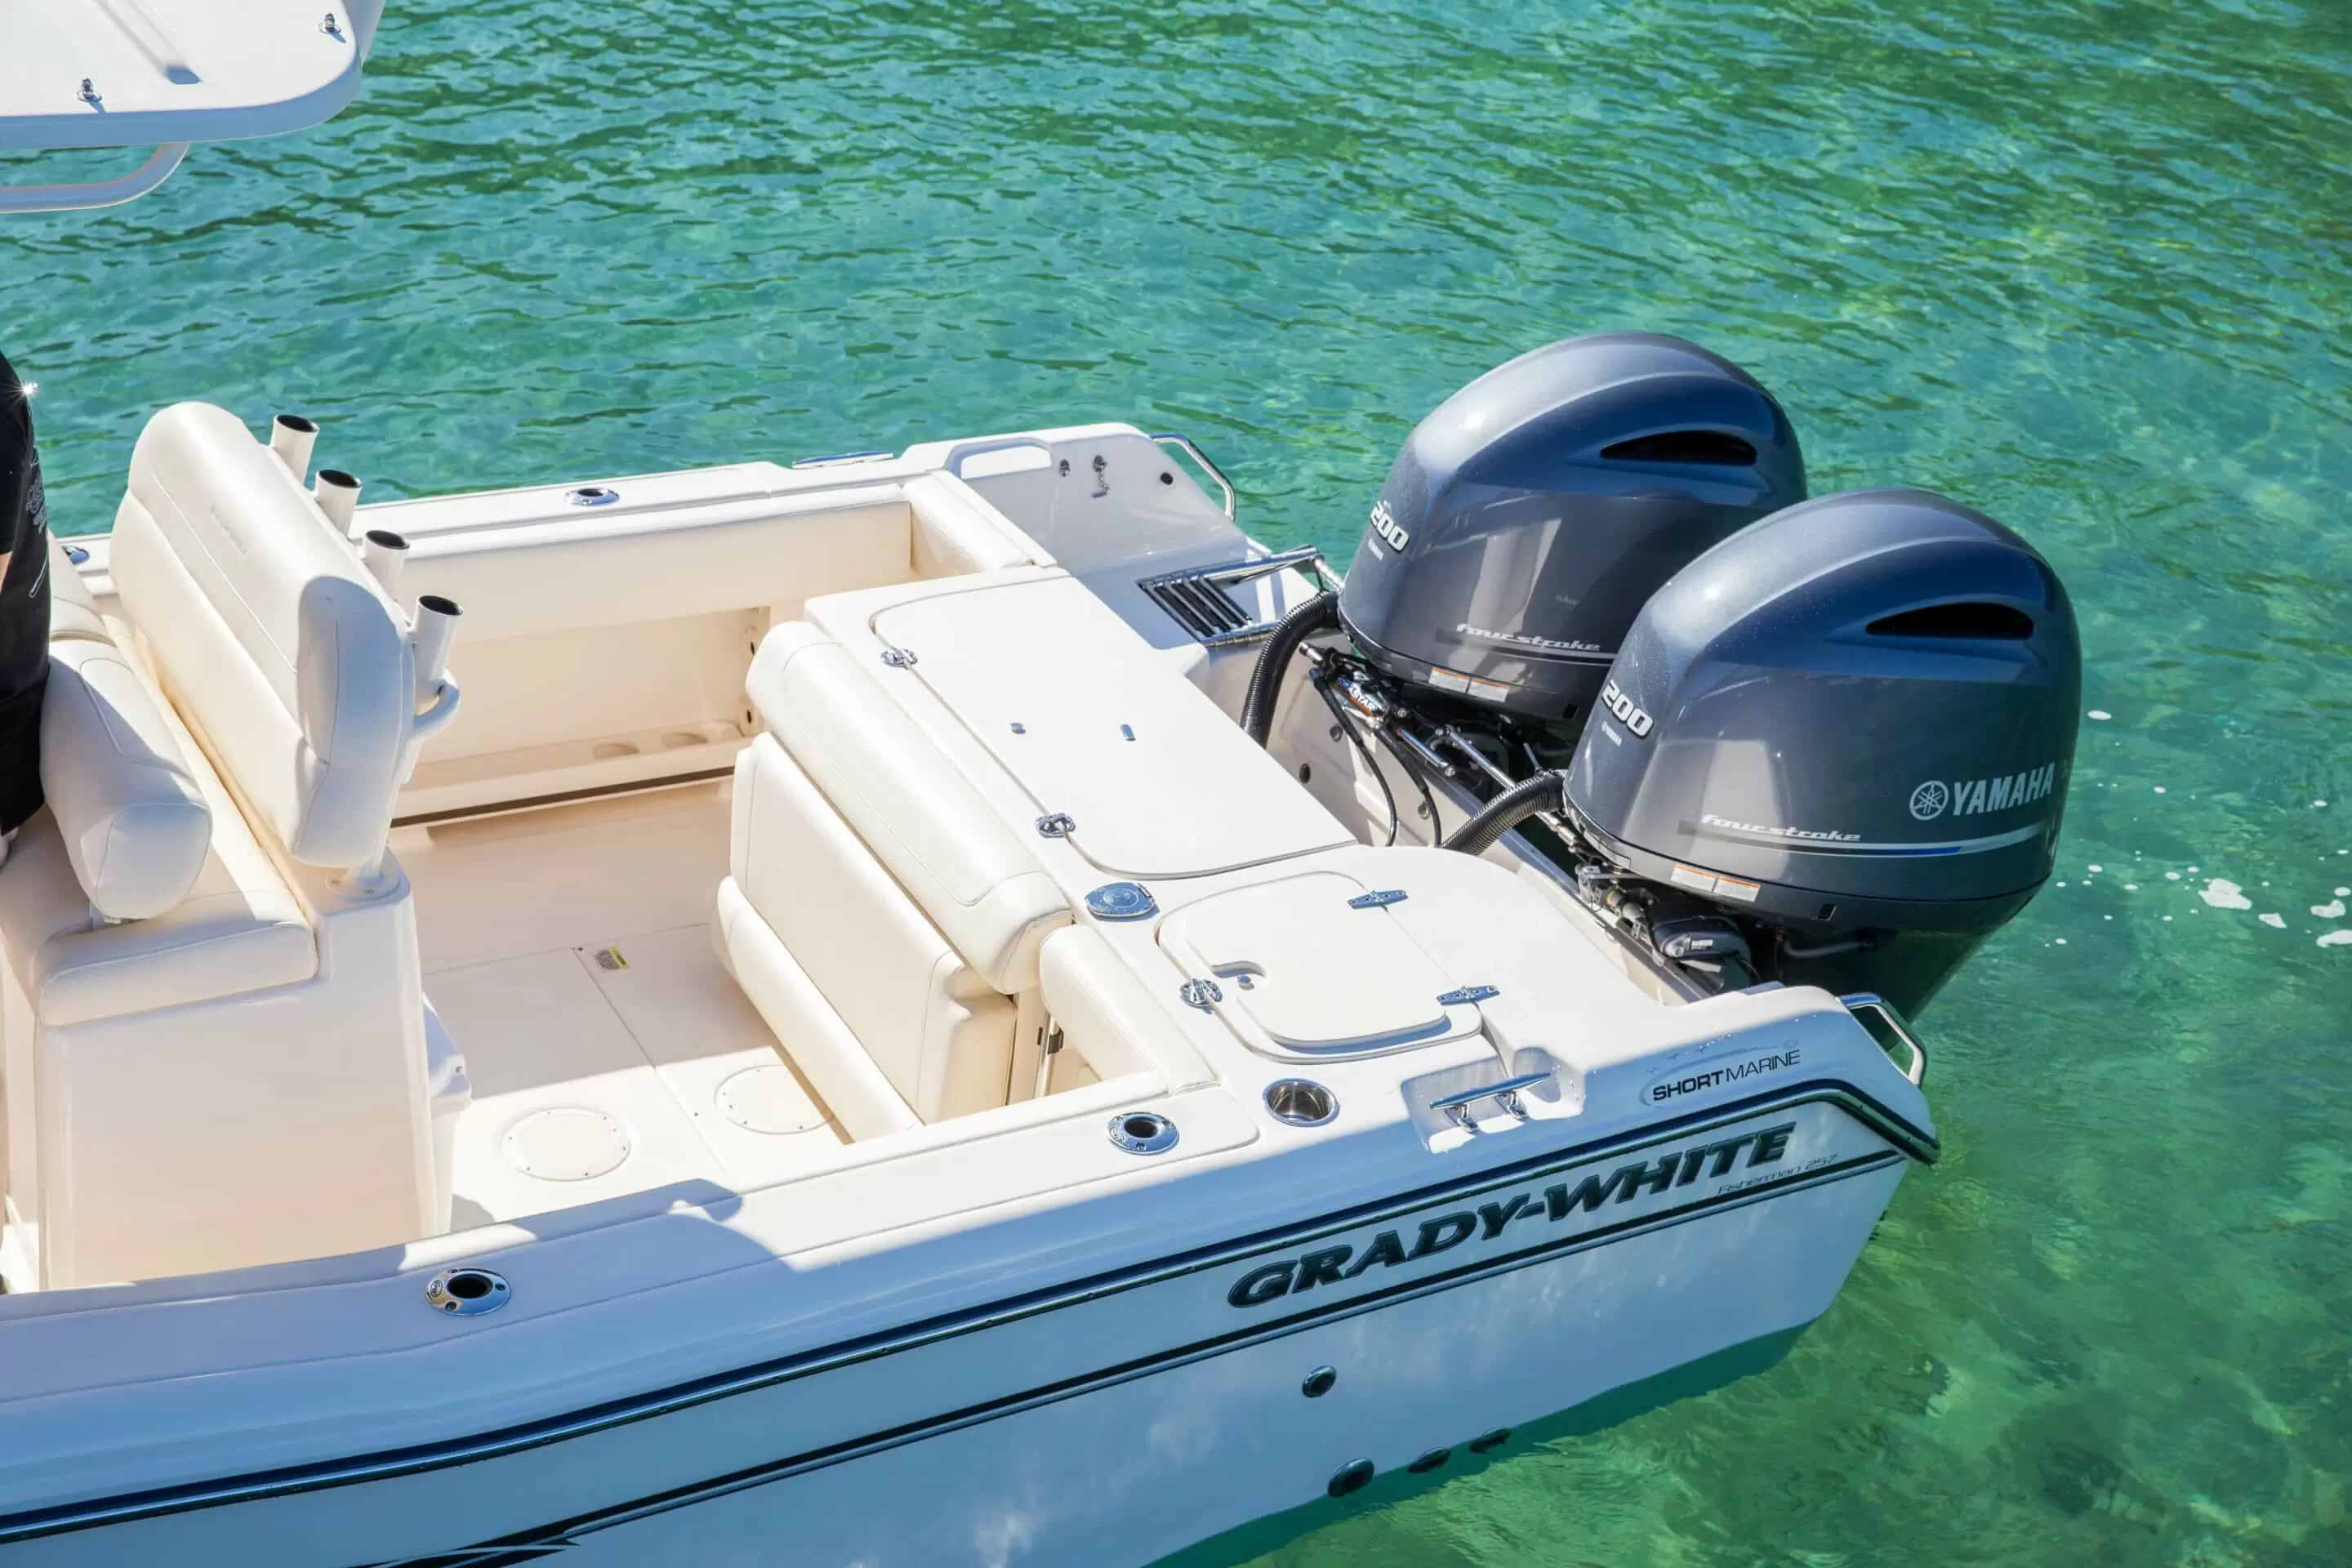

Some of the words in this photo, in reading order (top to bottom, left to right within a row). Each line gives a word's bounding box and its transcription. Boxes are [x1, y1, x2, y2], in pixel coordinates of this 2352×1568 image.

[1370, 500, 1410, 551] 200
[1456, 623, 1601, 652] fourstroke
[1601, 679, 1654, 738] 200
[1953, 761, 2055, 817] YAMAHA
[1700, 814, 1862, 841] fourstroke
[1227, 1122, 1797, 1308] GRADY-WHITE
